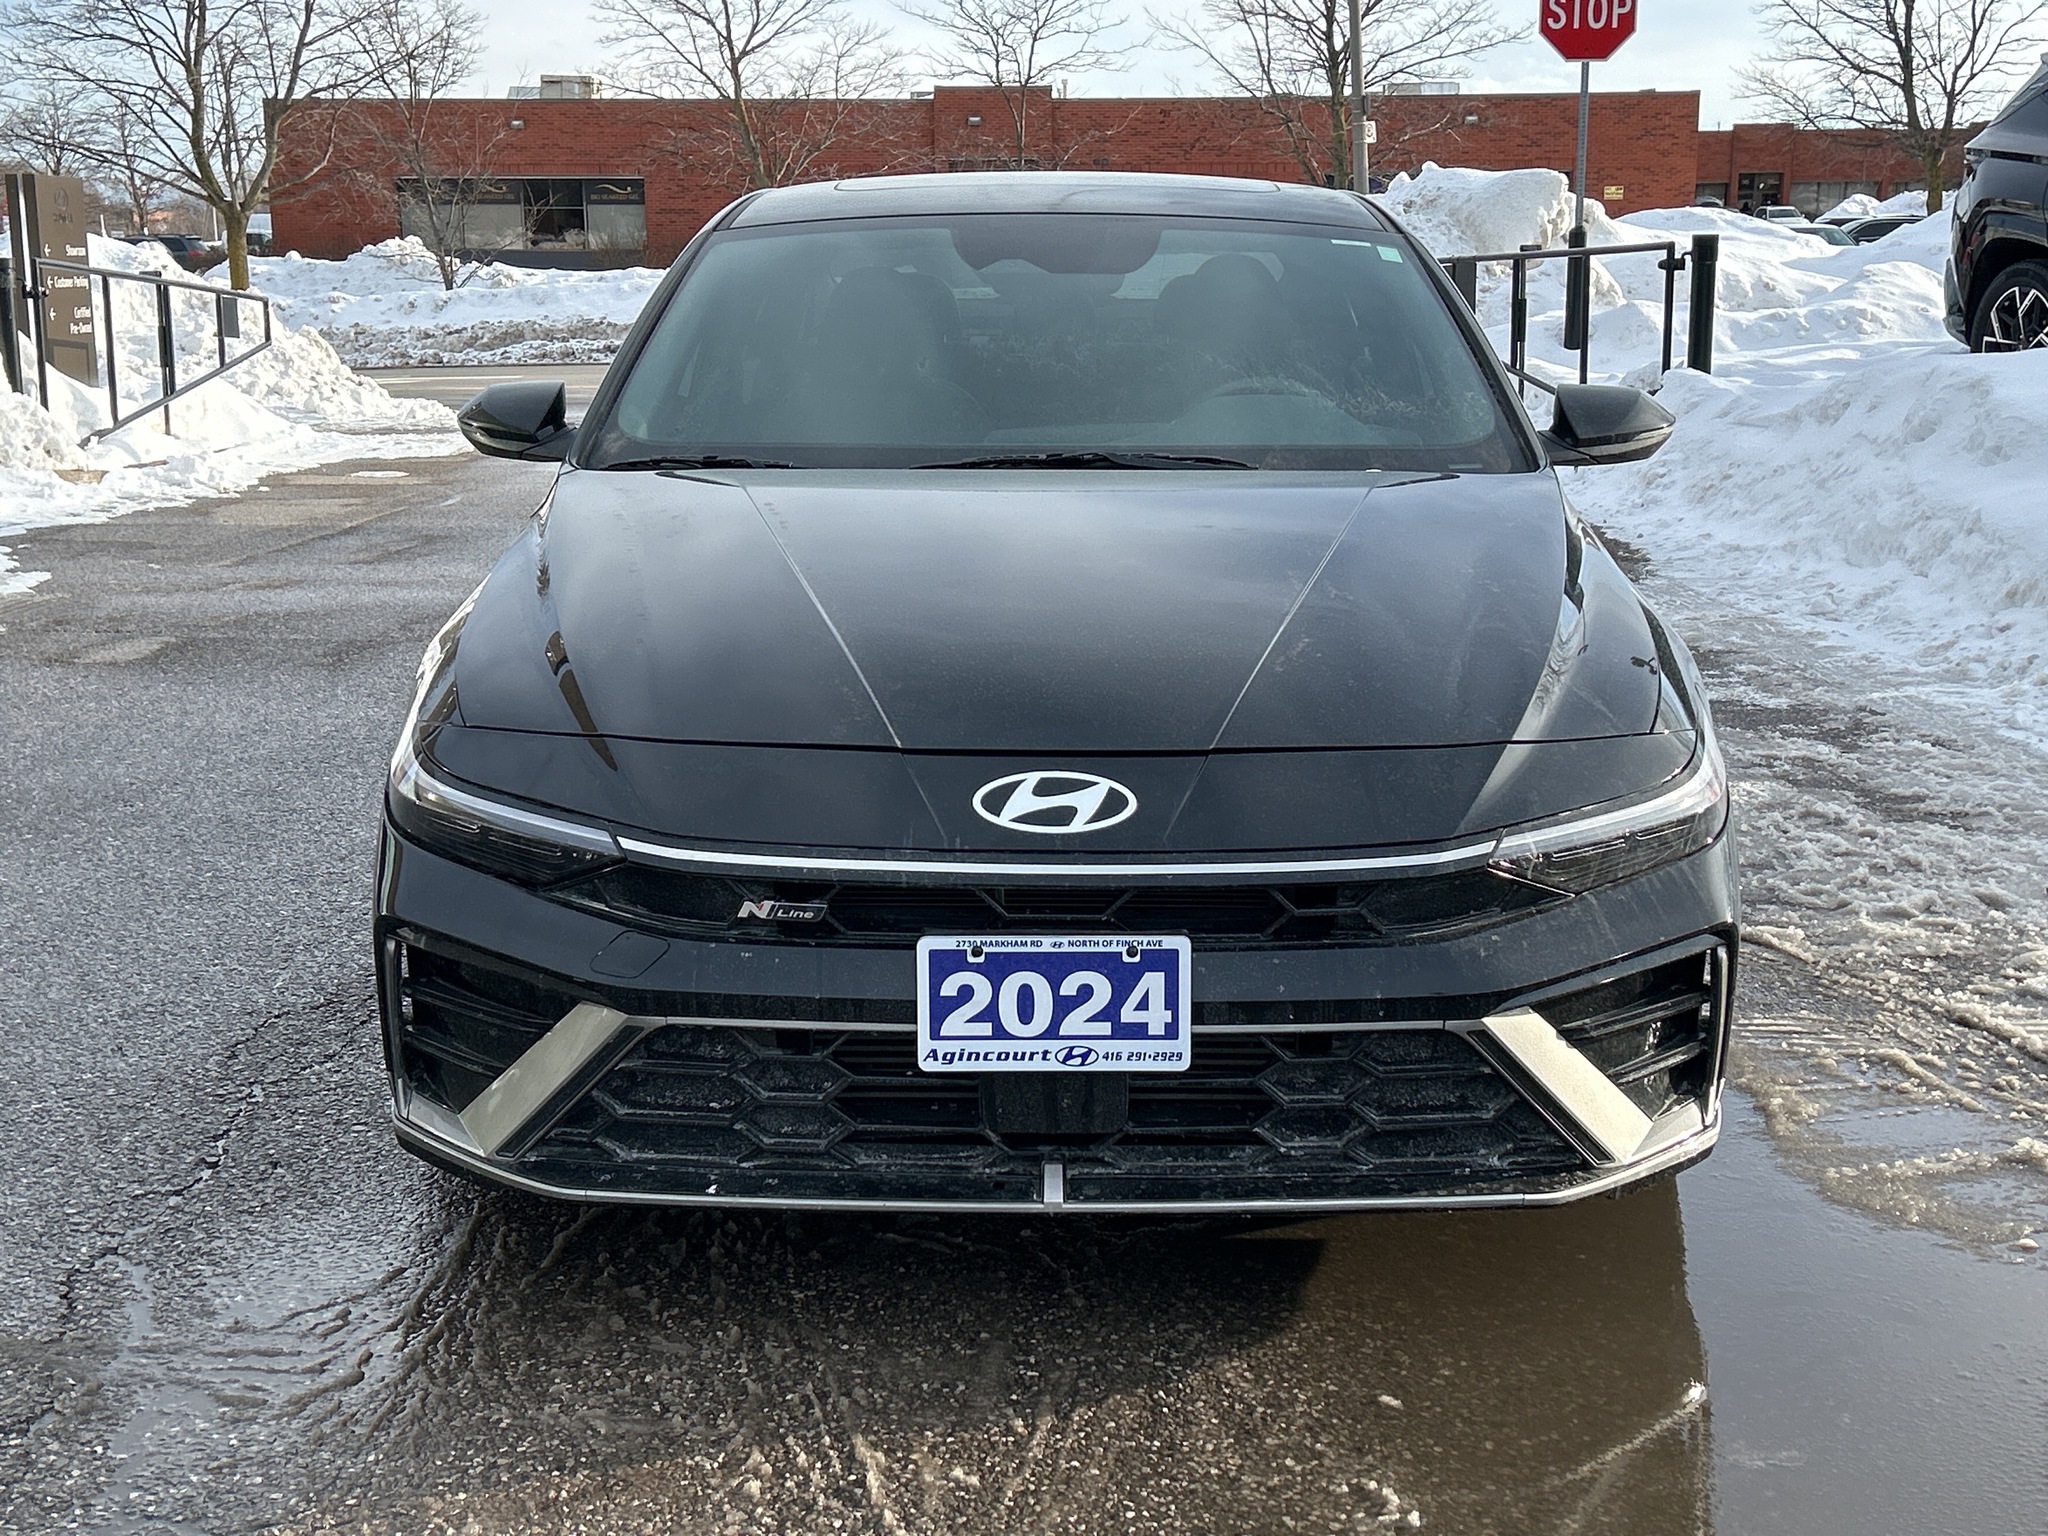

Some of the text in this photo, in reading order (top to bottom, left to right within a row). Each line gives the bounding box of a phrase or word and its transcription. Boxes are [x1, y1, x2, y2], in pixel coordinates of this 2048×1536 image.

[1547, 0, 1632, 29] STOP
[737, 900, 774, 919] N
[955, 939, 1163, 948] 2730 MARKHAM RD NORTH OF FINCH AVE
[939, 970, 1172, 1038] 2024
[923, 1048, 1052, 1065] Agincourt
[1102, 1051, 1123, 1062] 416
